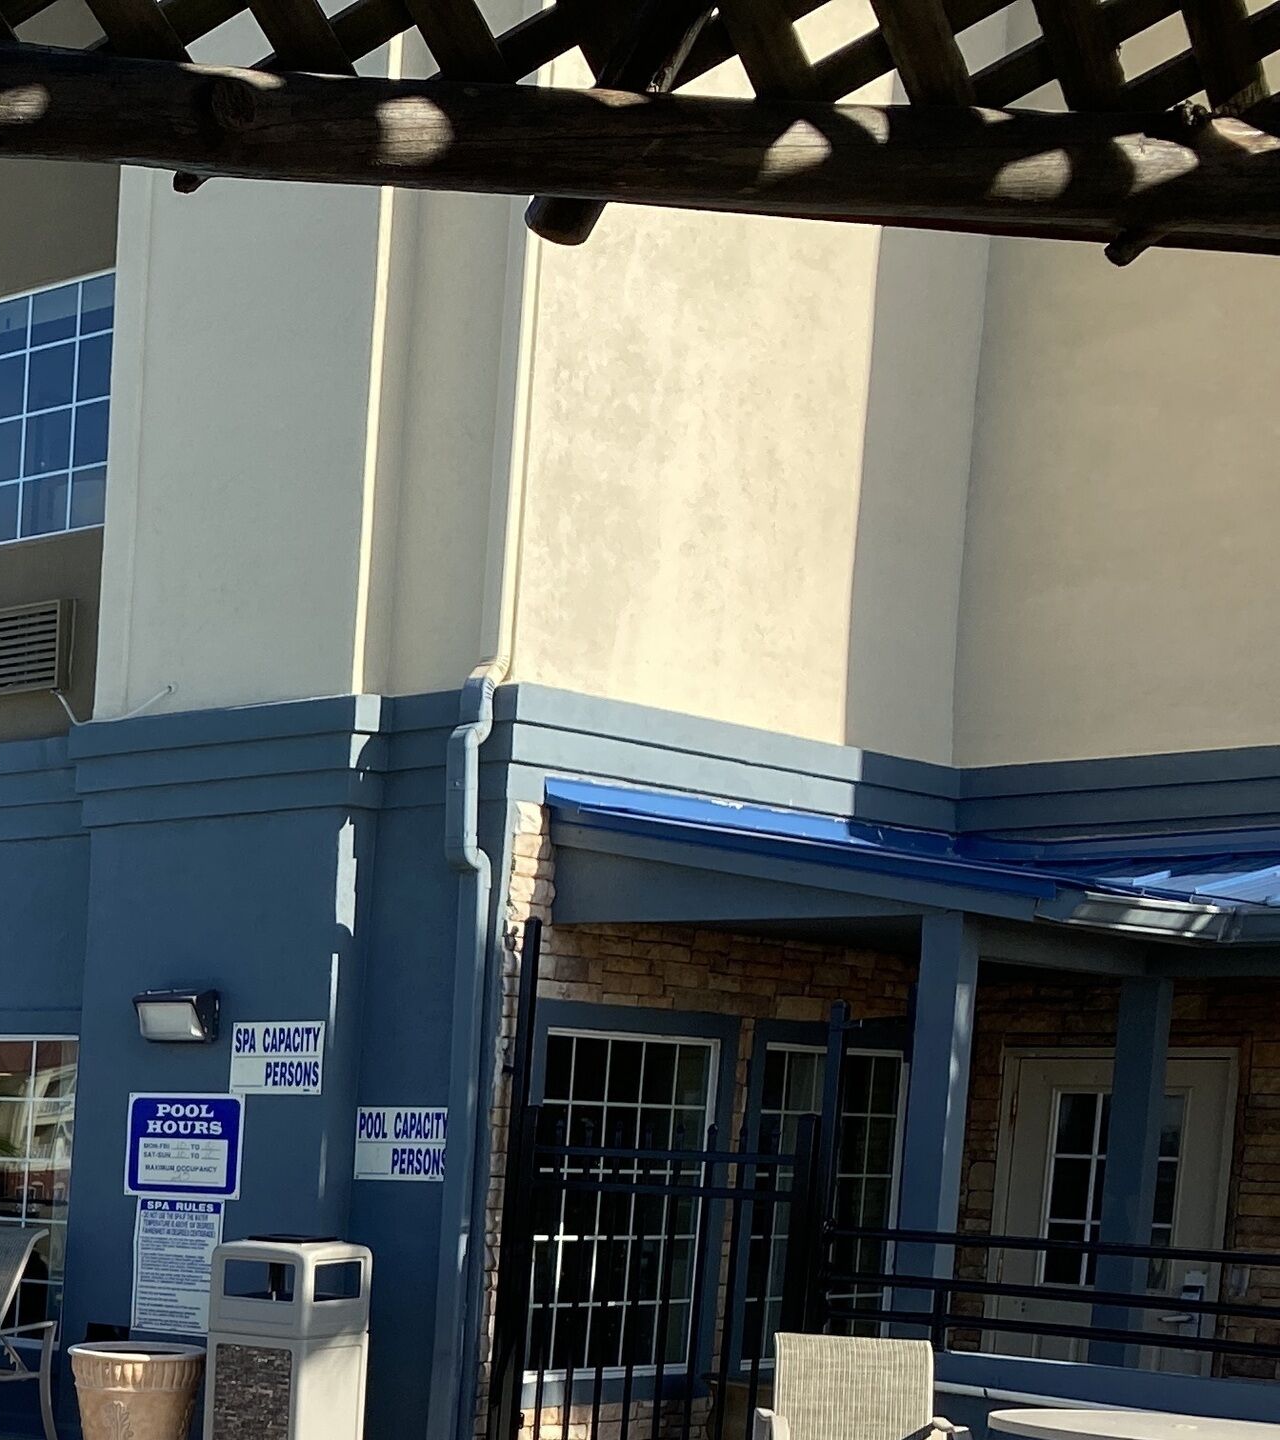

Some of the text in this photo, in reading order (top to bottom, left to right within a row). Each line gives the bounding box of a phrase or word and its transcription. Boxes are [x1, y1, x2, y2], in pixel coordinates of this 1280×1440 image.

[235, 1027, 321, 1053] SPA CAPACITY
[264, 1061, 319, 1087] PERSONS
[156, 1104, 215, 1118] POOL
[146, 1120, 222, 1135] HOURS
[359, 1112, 388, 1139] POOL
[147, 1200, 214, 1212] SPA RULES
